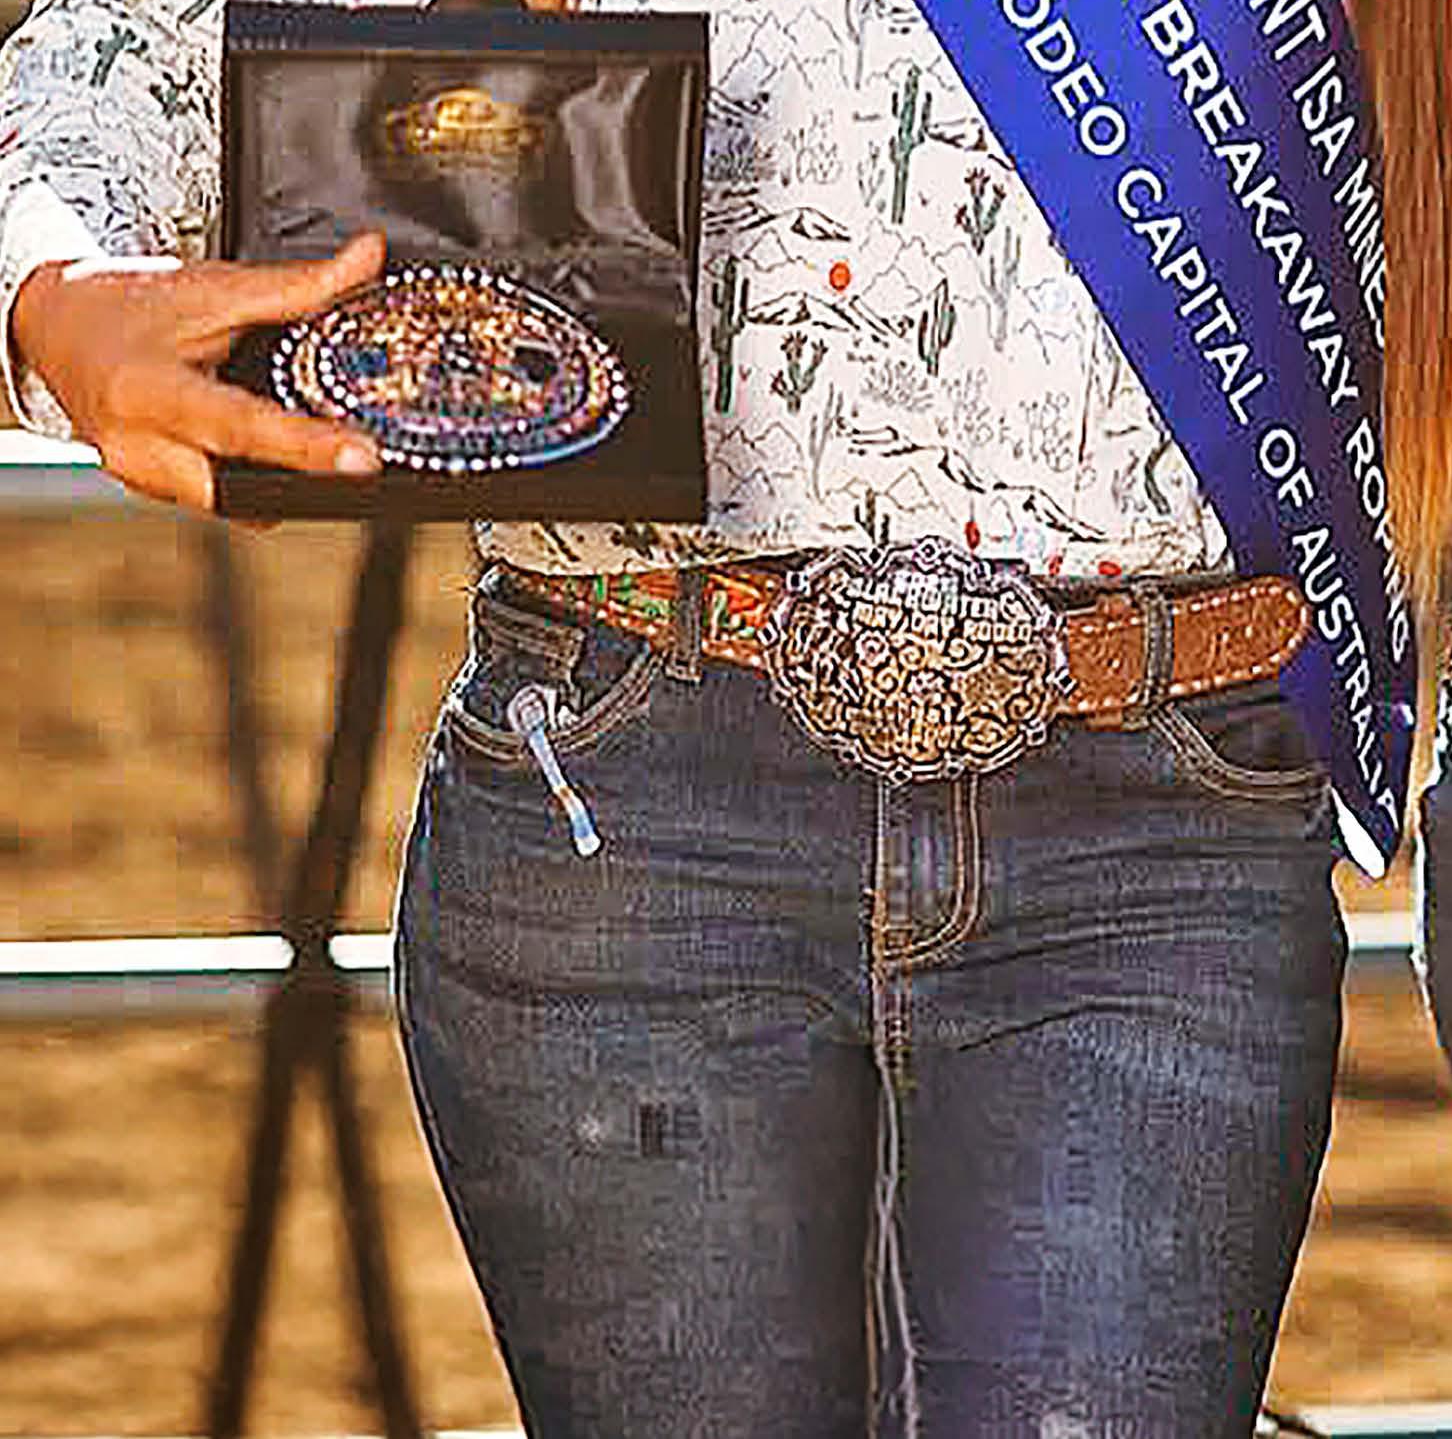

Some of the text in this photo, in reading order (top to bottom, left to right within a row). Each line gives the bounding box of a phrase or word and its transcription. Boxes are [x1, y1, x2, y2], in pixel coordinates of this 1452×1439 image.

[1293, 56, 1354, 175] ISA
[1117, 170, 1267, 424] CAPITAL
[1260, 429, 1314, 507] OF
[1292, 527, 1399, 830] AUSTRALIA
